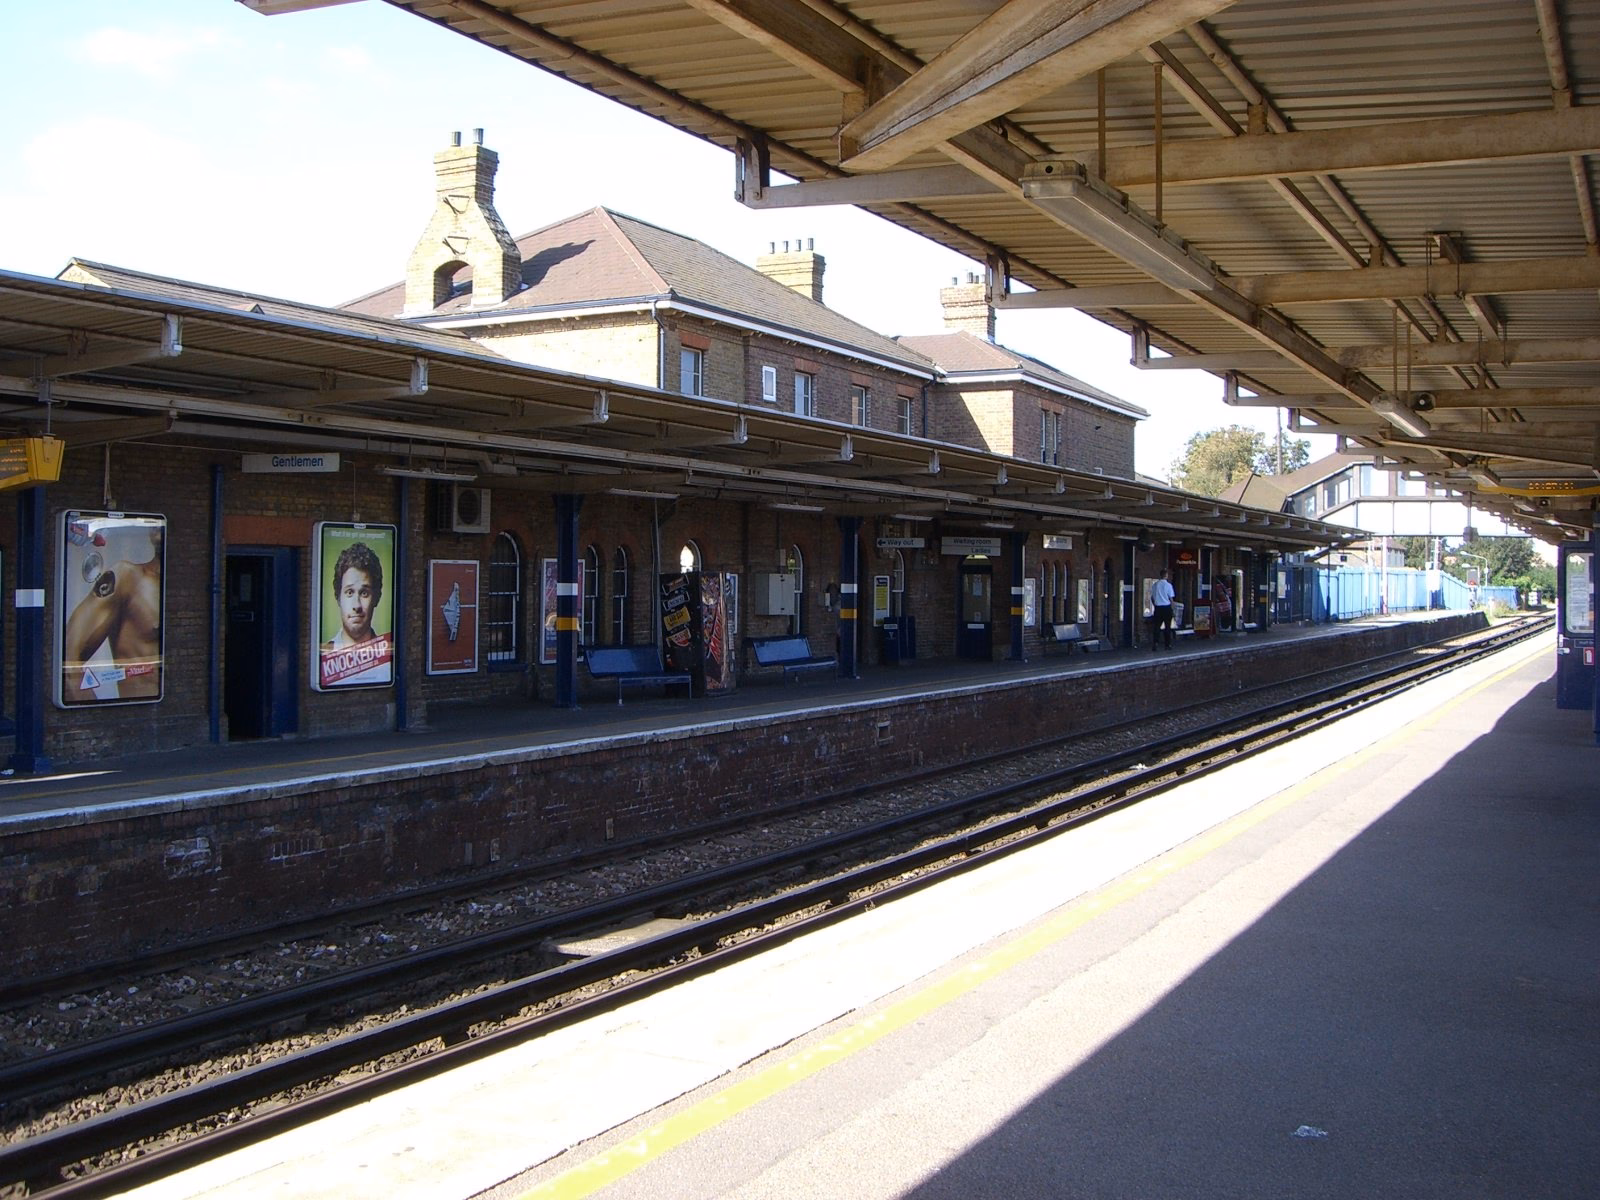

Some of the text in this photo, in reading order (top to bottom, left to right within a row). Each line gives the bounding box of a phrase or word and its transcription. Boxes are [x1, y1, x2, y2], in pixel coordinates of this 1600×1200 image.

[271, 455, 323, 467] Gentlemen
[887, 539, 901, 547] Way
[323, 645, 374, 677] KNOCKED
[374, 640, 389, 658] UP
